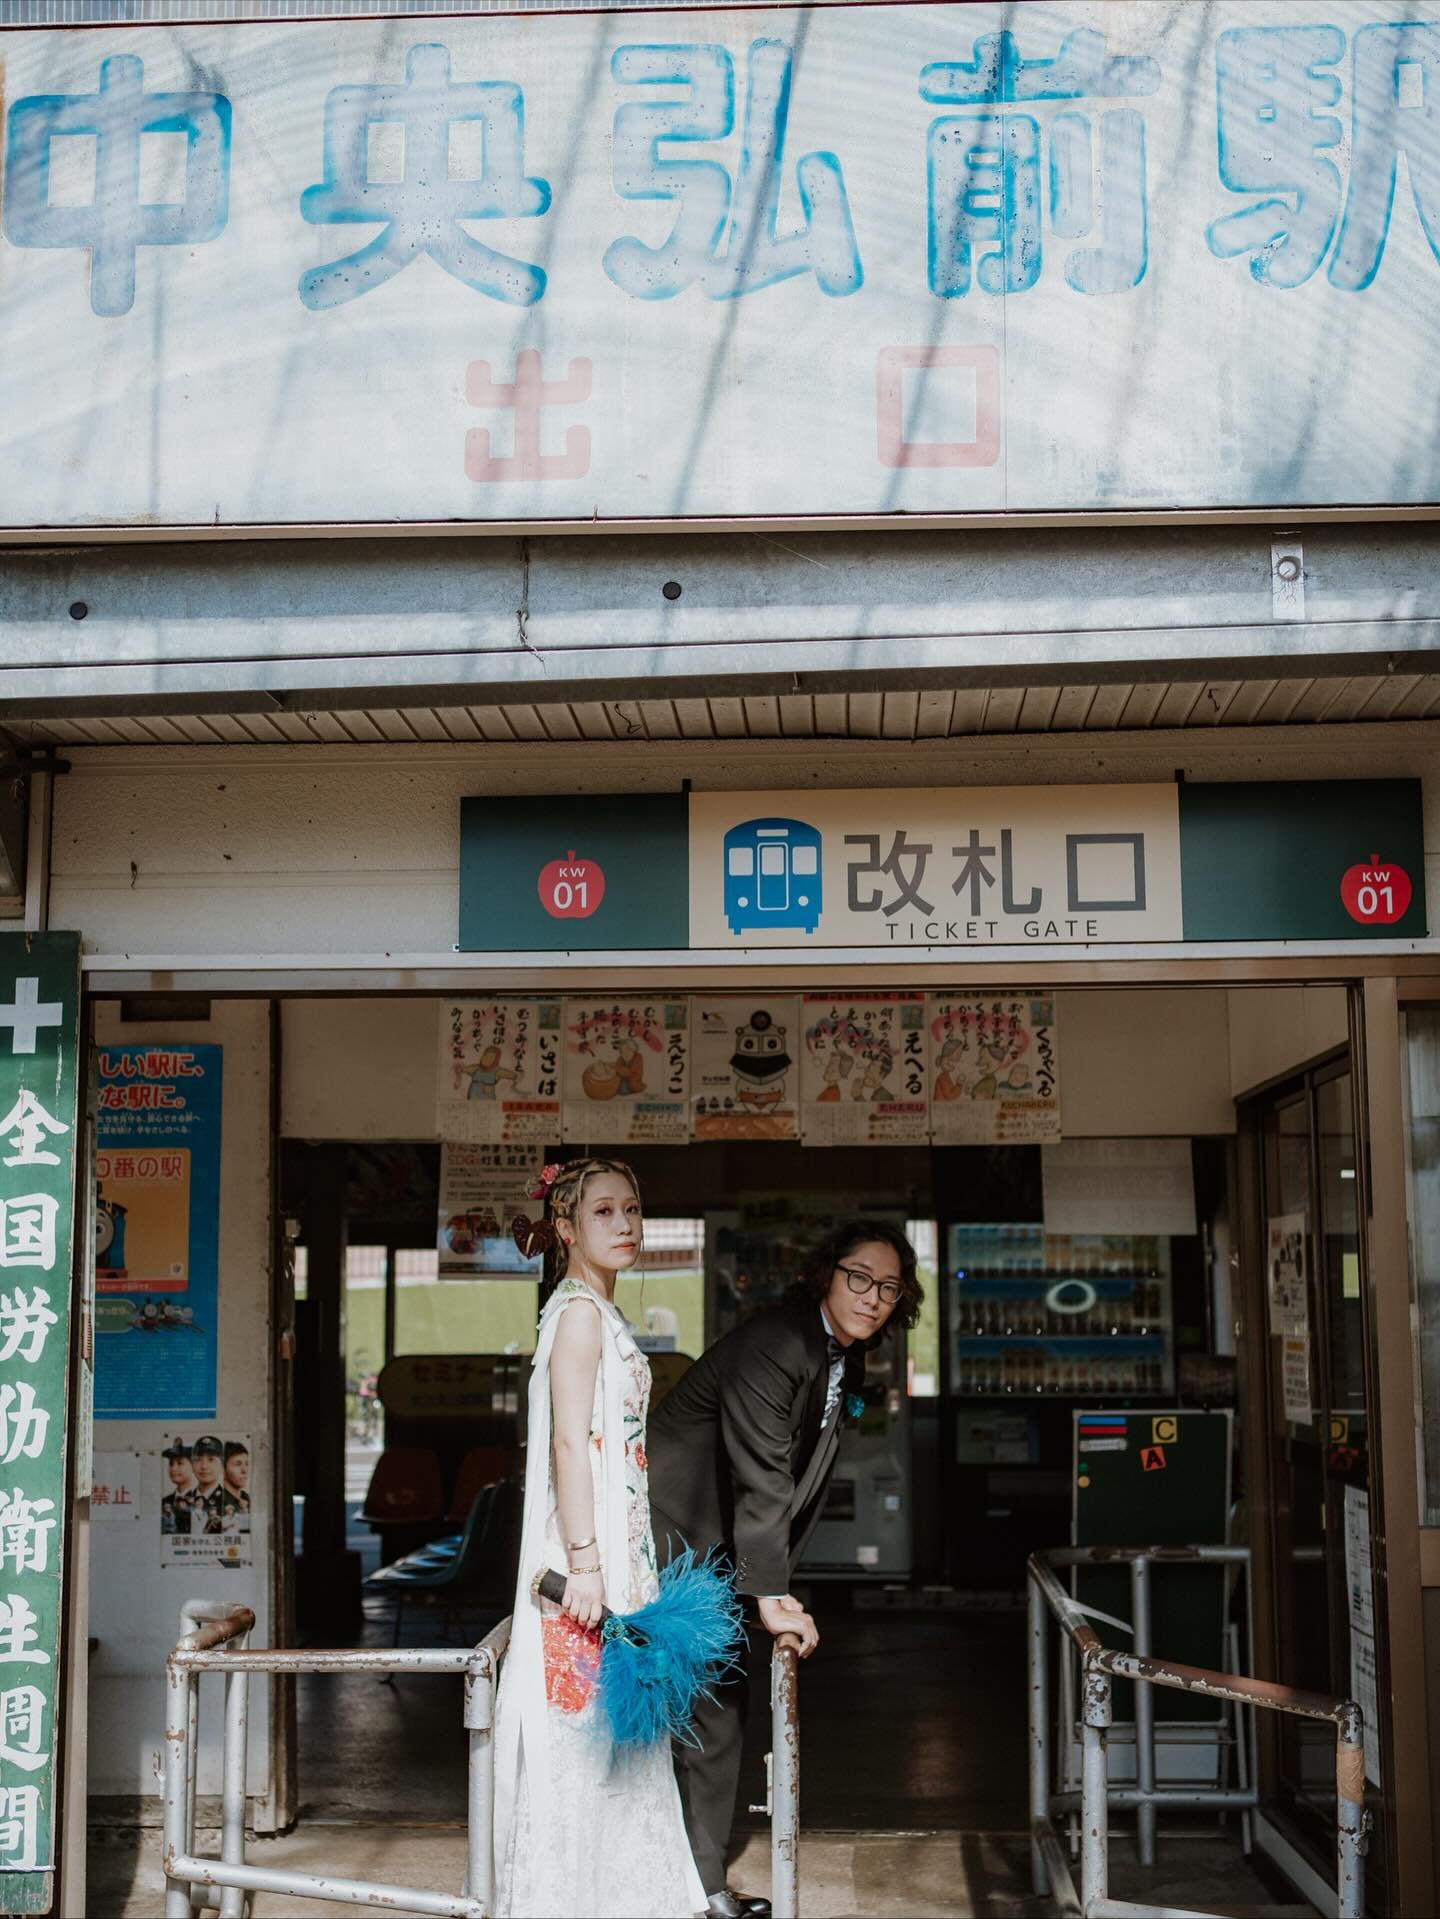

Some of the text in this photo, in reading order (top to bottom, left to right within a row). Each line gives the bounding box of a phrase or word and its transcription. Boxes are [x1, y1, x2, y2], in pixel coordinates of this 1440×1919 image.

[3, 22, 1440, 318] 中央弘前駅
[464, 344, 1001, 482] 出口
[559, 867, 586, 878] KW
[844, 829, 1147, 919] 改札口
[1362, 871, 1391, 882] KW
[552, 881, 588, 911] 01
[1356, 886, 1395, 915] 01
[886, 919, 1099, 940] TICKET GATE
[905, 1032, 924, 1095] えへる
[1154, 1419, 1175, 1441] C
[1145, 1450, 1163, 1469] A
